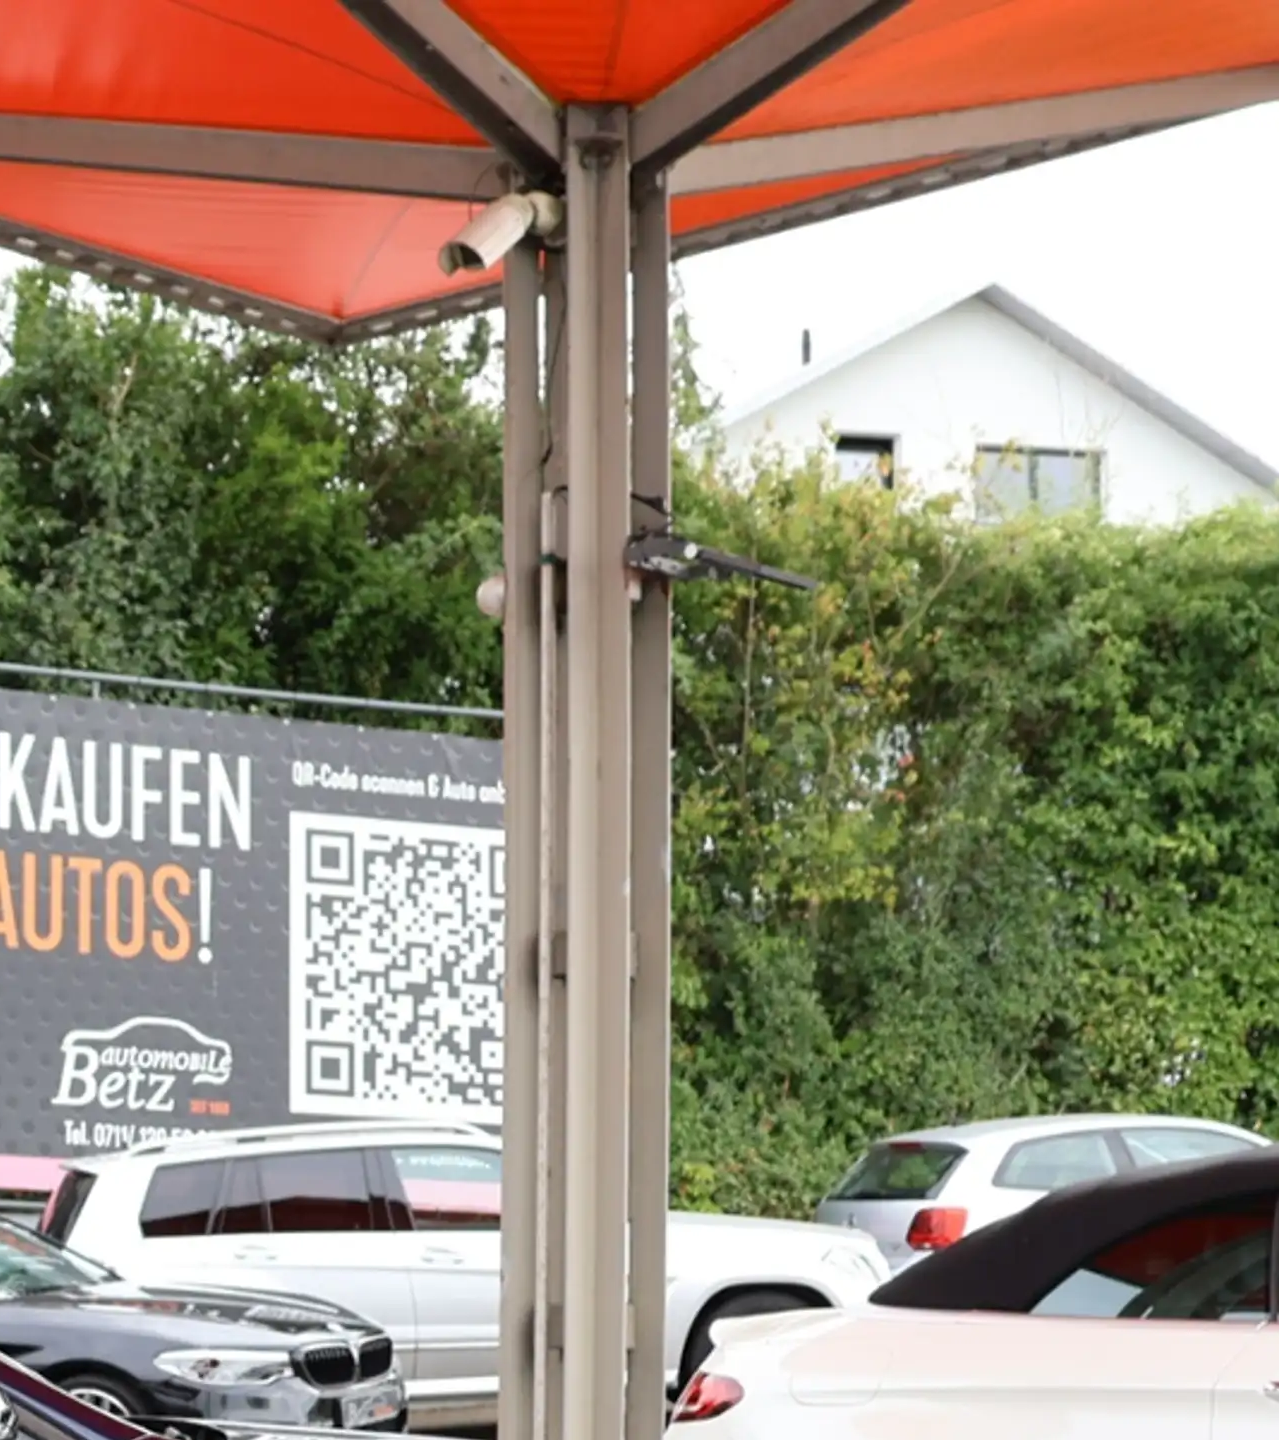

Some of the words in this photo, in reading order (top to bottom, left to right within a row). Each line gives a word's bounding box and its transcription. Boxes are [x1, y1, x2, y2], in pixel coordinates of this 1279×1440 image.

[292, 760, 358, 792] QR-Code
[51, 1046, 176, 1112] Betz
[63, 1119, 90, 1146] Tel.
